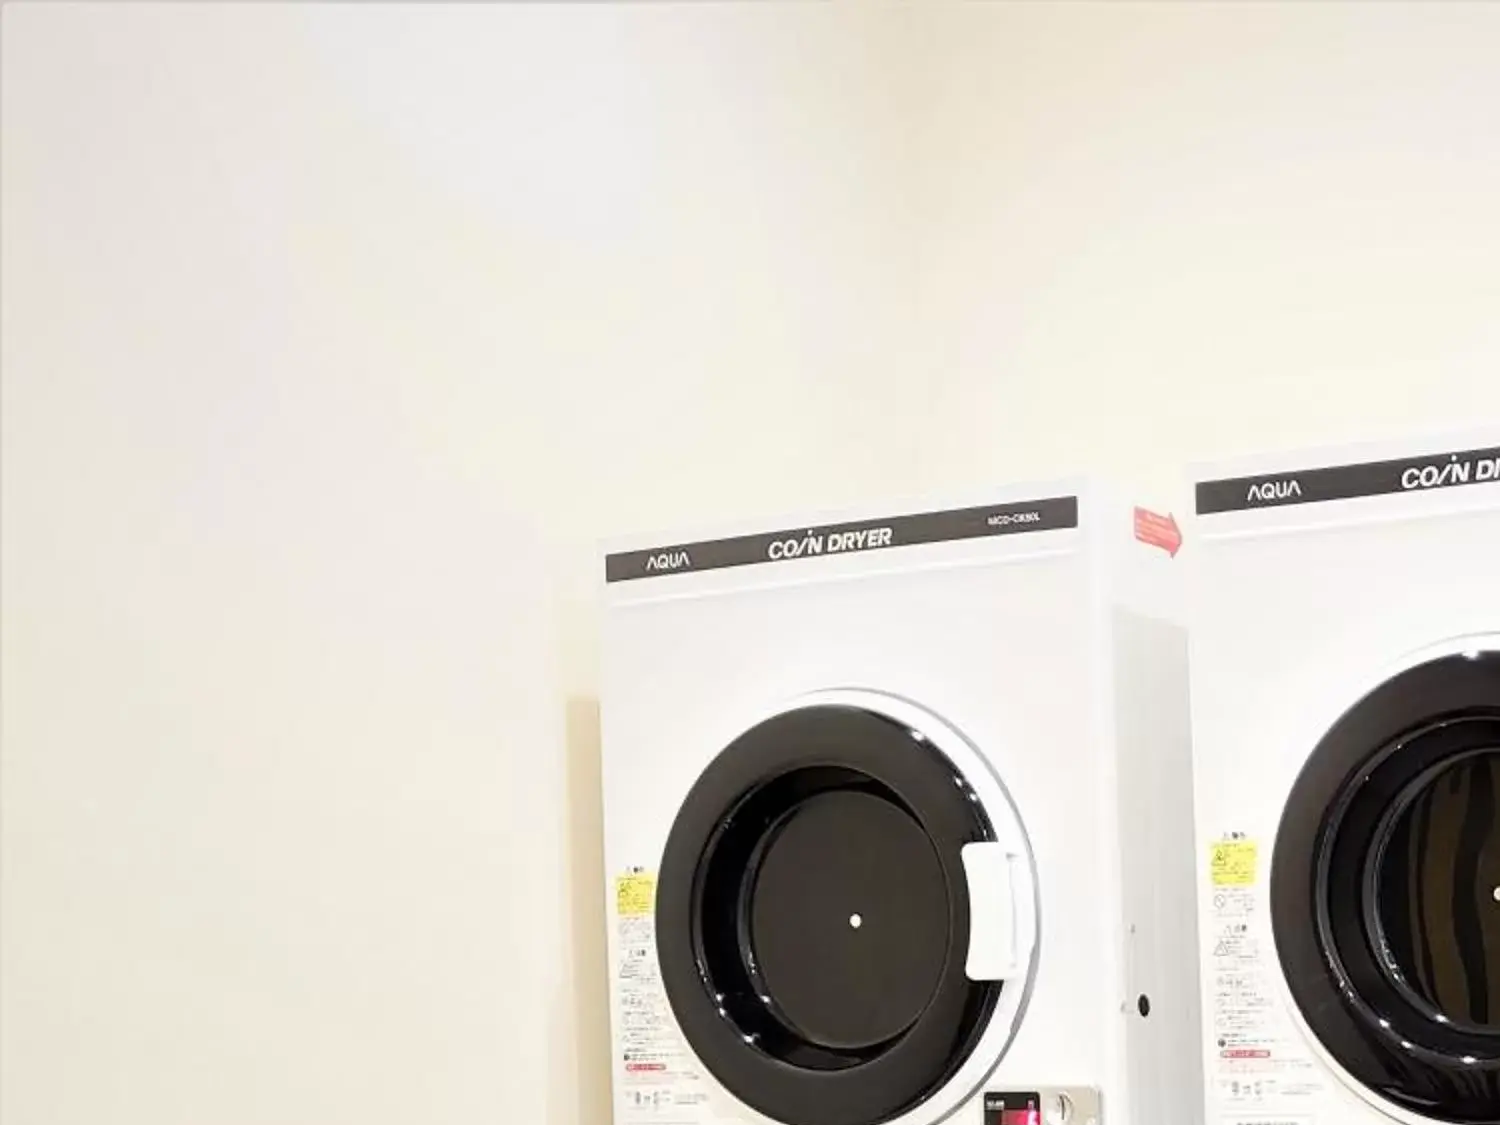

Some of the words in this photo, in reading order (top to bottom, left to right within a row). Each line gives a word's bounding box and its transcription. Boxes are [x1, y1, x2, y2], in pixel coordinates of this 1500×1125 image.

[1247, 480, 1301, 501] AQUA
[826, 527, 893, 553] DRYER
[645, 551, 690, 571] AQUA
